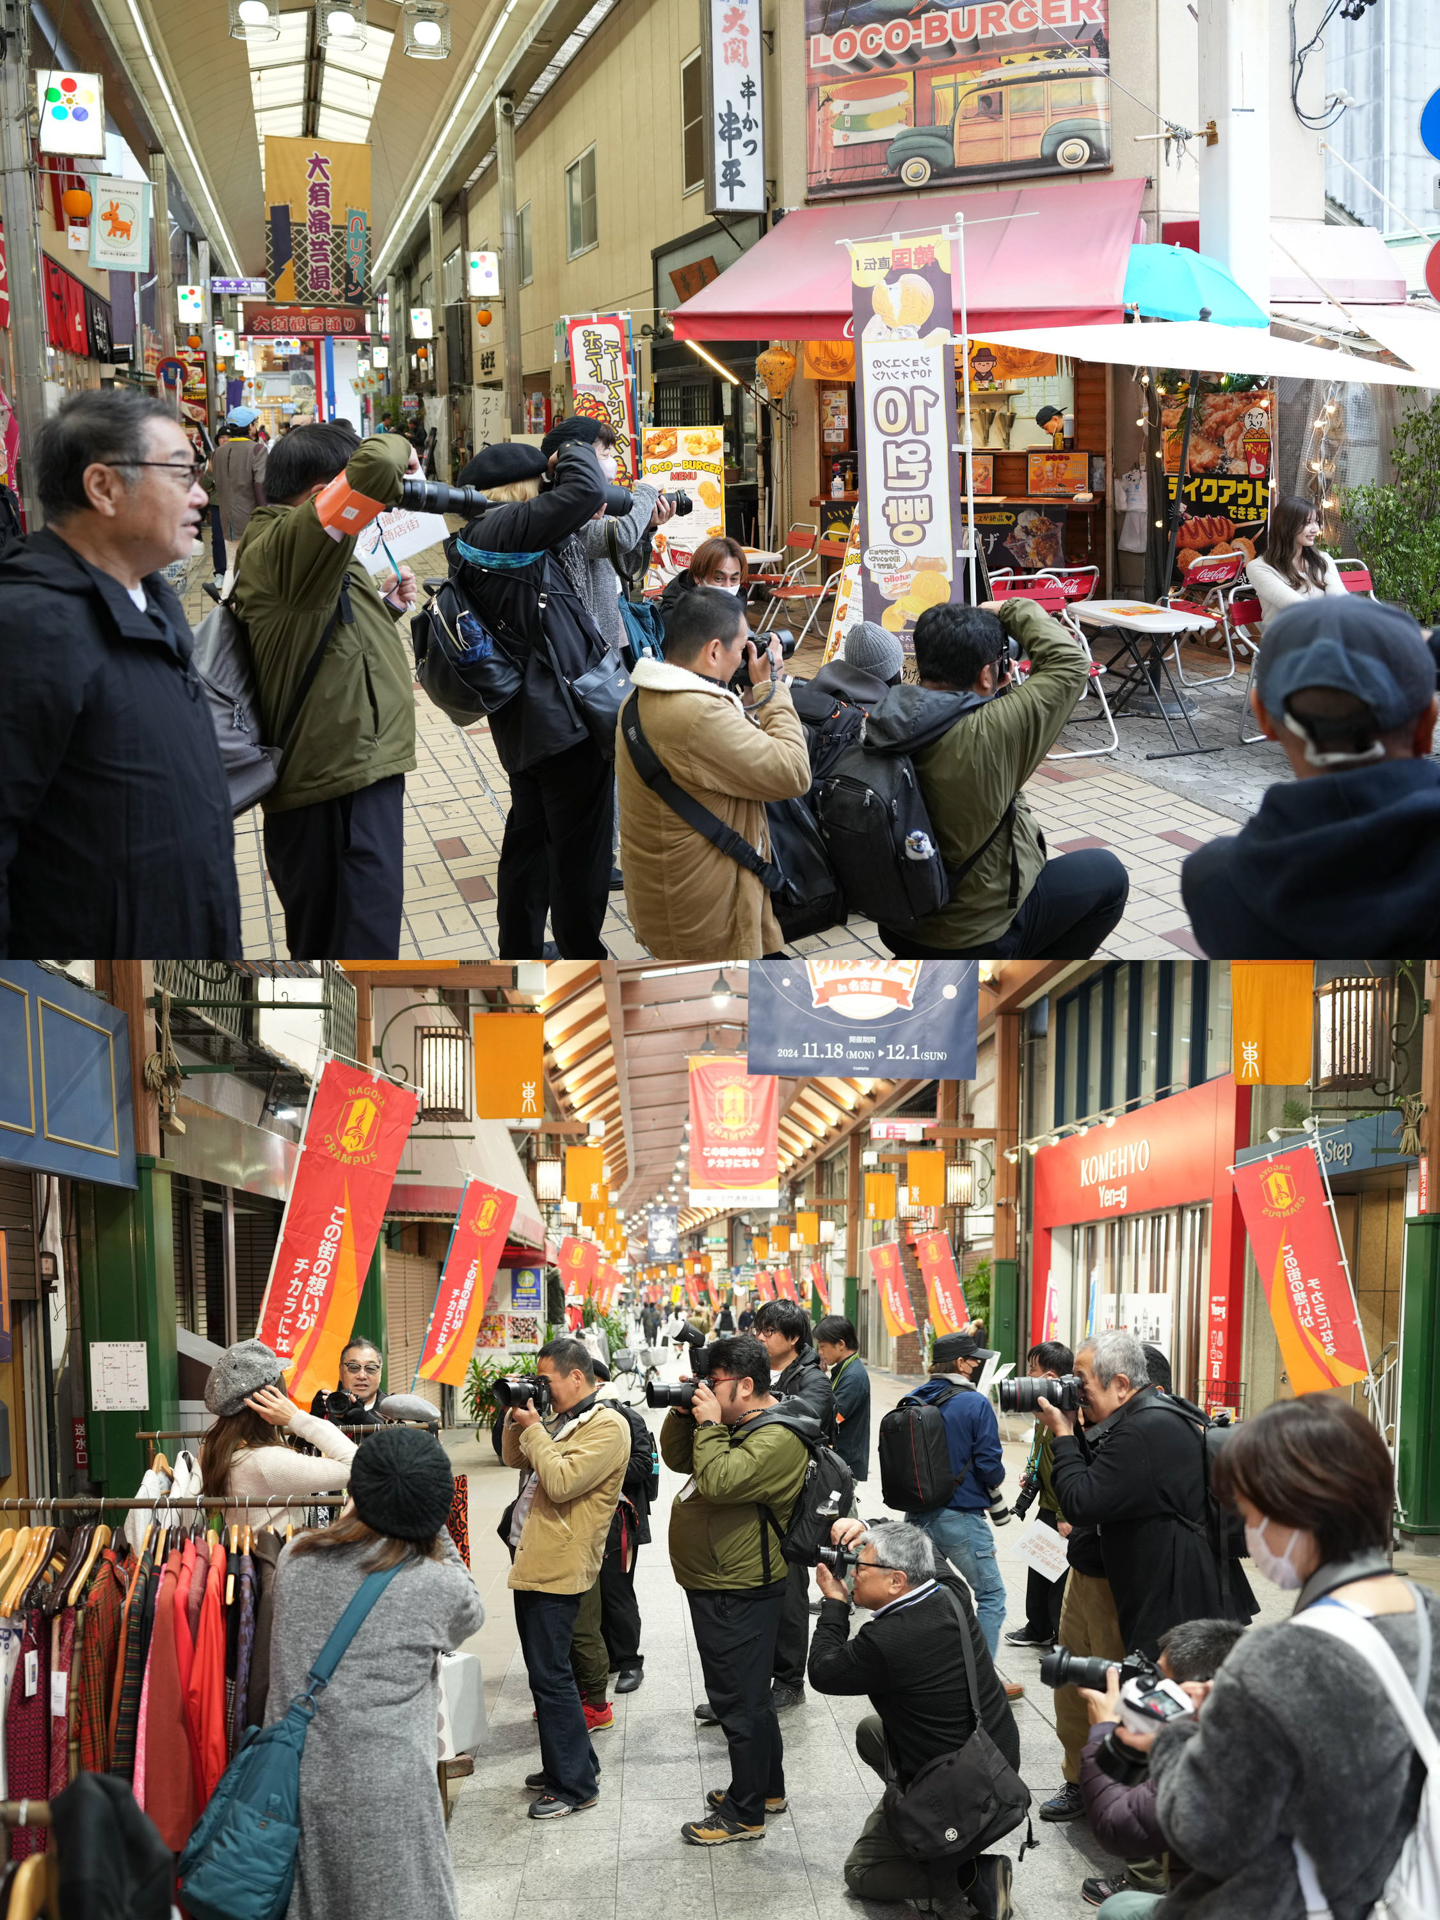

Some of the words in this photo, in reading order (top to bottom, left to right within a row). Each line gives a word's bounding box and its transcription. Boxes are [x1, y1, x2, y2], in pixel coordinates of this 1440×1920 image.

[722, 6, 750, 68] 大関
[811, 0, 1106, 68] LOCO-BURGER
[740, 75, 759, 156] 串かつ
[719, 100, 746, 202] 串平
[306, 152, 332, 292] 大須演芸場
[348, 238, 362, 296] Uターン
[253, 315, 356, 332] 大須観音通り
[1247, 412, 1264, 420] カップ
[670, 471, 697, 481] MENU
[681, 460, 722, 475] BURGER
[1168, 477, 1269, 506] テイクアウト
[1228, 505, 1269, 521] できます
[1196, 566, 1231, 583] Coca-Cola
[848, 979, 883, 993] 名古屋
[777, 1049, 799, 1058] 2024
[802, 1043, 844, 1059] 11.18
[845, 1051, 875, 1060] (MON)
[886, 1044, 920, 1060] 12.1
[920, 1052, 947, 1061] (SUN)
[1241, 1041, 1260, 1078] 東
[348, 1086, 386, 1108] NAGOYA
[521, 1081, 537, 1113] 東
[715, 1075, 752, 1088] NAGOYA
[708, 1121, 760, 1140] GRAMPUS
[324, 1134, 377, 1165] GRAMPUS
[1081, 1140, 1150, 1187] KOMEHYO
[469, 1220, 496, 1238] GRAMPUS
[296, 1206, 347, 1330] この街の想いが
[276, 1258, 309, 1353] チカラにな
[452, 1259, 480, 1330] この街の想いが
[435, 1289, 460, 1354] チカラになる
[75, 1424, 88, 1464] 送水口
